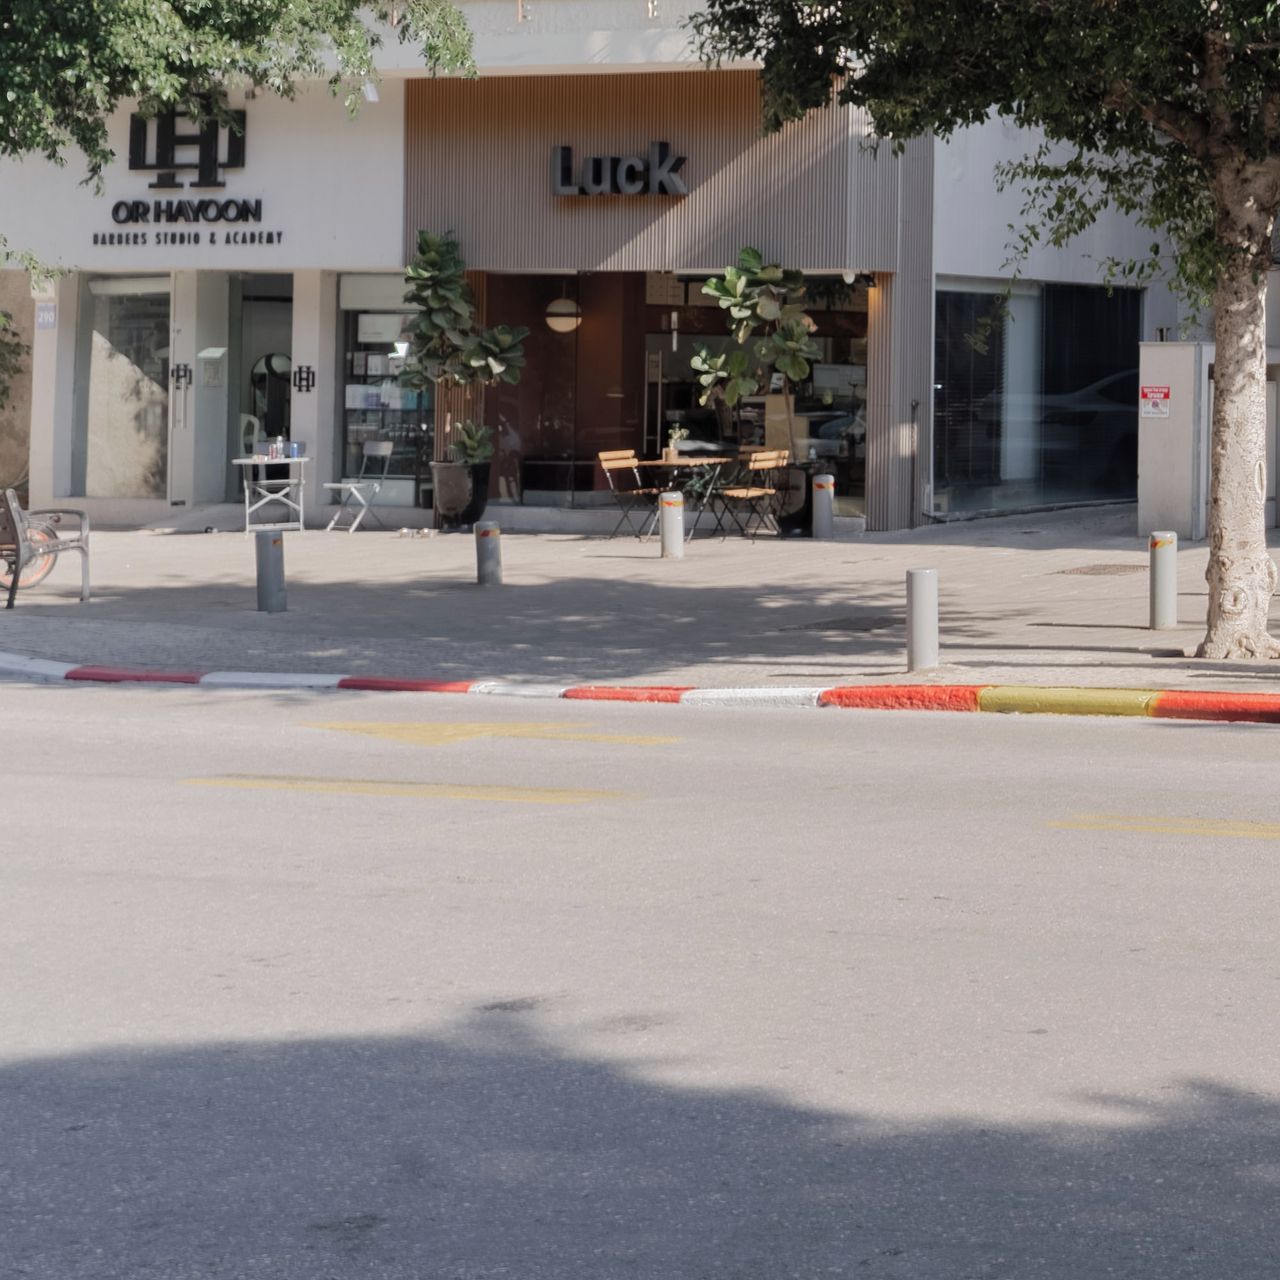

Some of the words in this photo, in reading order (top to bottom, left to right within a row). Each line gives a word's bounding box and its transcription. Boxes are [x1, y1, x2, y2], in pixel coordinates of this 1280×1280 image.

[551, 141, 689, 195] Luck
[112, 200, 150, 224] OR
[153, 199, 262, 223] HAYOON
[155, 232, 200, 245] STUDIO
[209, 232, 217, 245] &
[225, 231, 283, 245] ACADEMY
